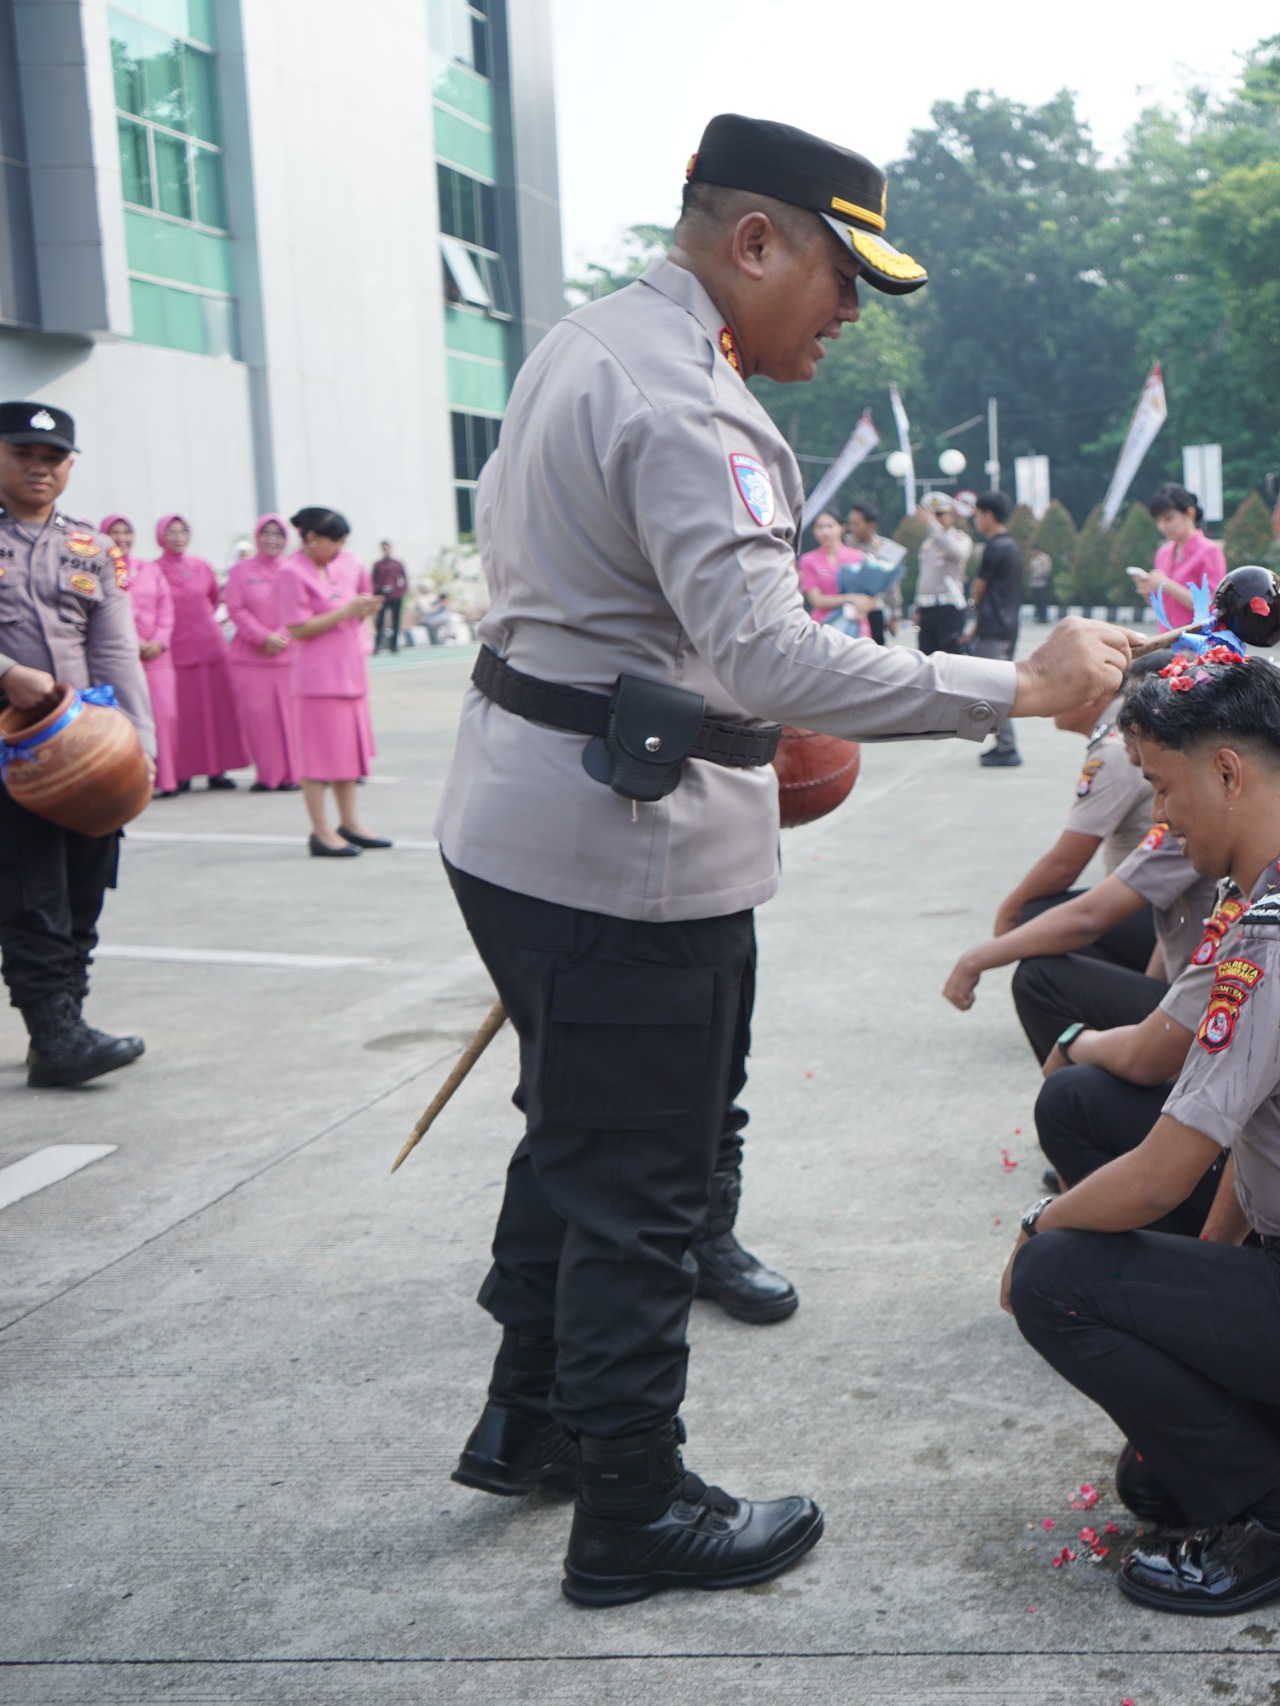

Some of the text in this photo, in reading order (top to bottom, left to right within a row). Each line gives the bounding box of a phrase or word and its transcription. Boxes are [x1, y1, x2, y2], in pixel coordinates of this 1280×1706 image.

[60, 556, 102, 575] POLRI
[1218, 960, 1259, 979] POLRESTA
[1213, 985, 1245, 1000] BANTEN
